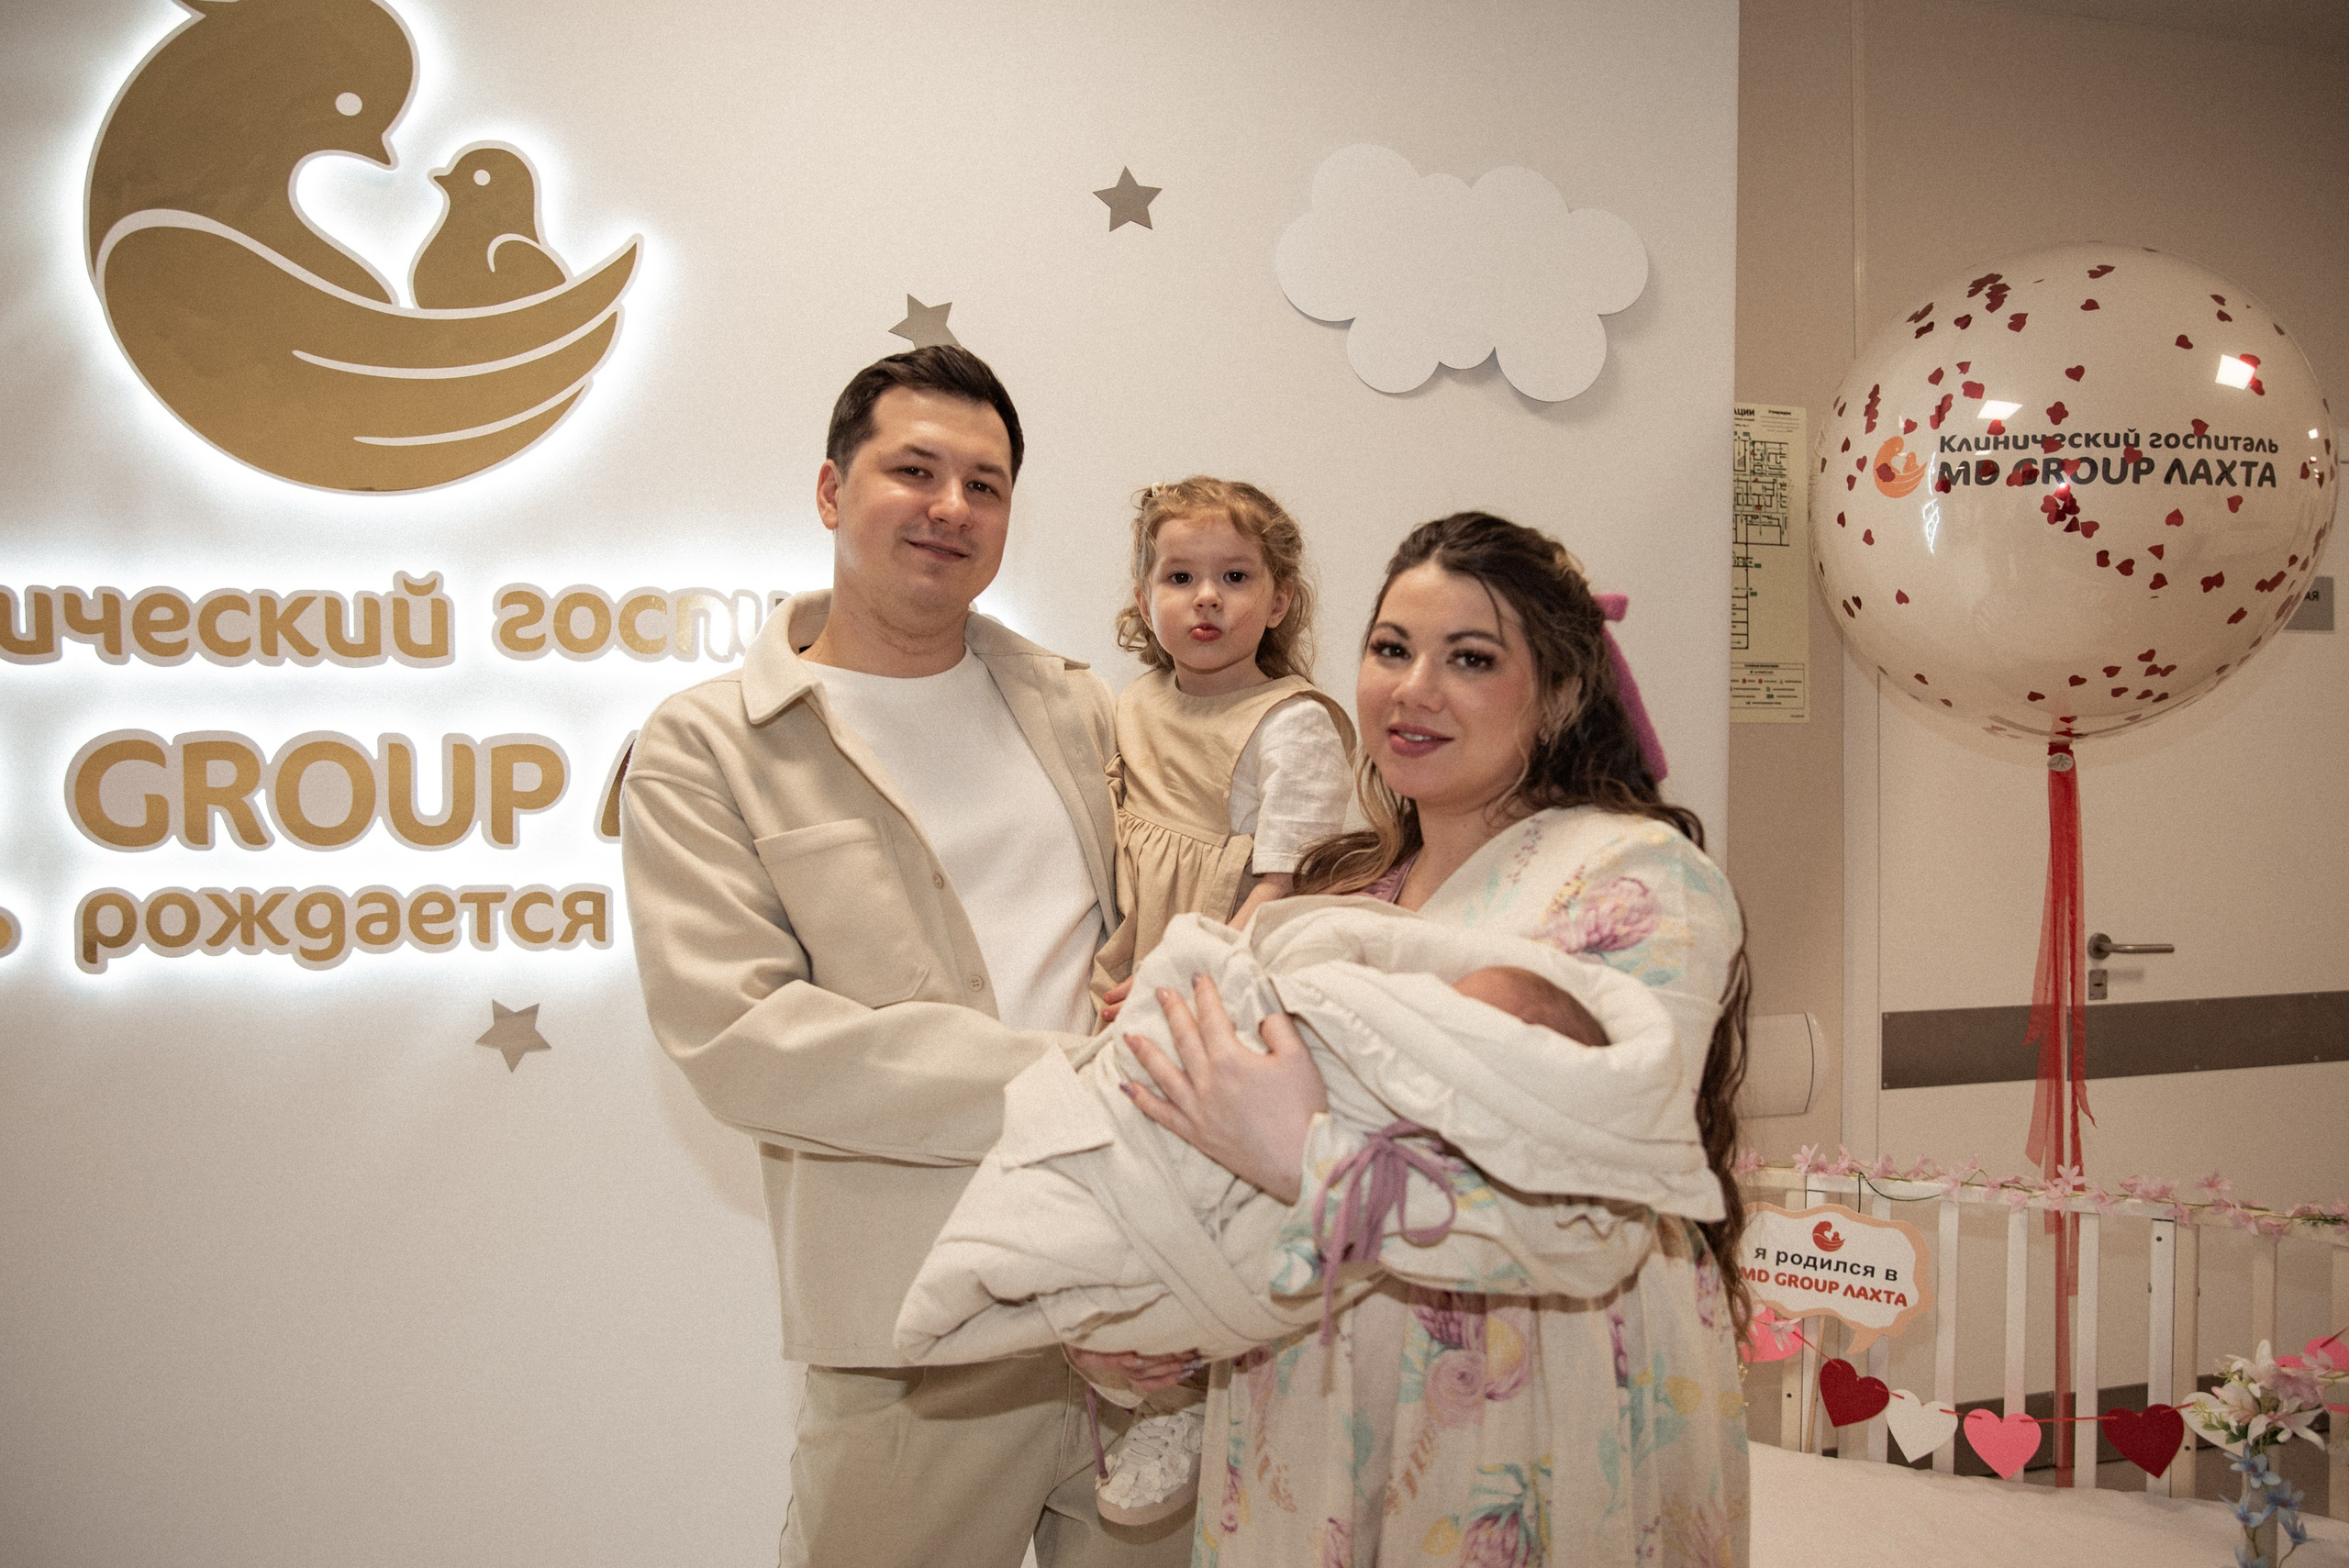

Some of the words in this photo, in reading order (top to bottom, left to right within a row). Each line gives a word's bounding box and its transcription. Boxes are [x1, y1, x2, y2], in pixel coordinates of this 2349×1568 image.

[2149, 433, 2278, 453] госпиталь
[1938, 461, 2000, 486] MD
[74, 740, 565, 847] GROUP
[83, 892, 607, 964] рождается
[1741, 1266, 1770, 1283] MD
[1774, 1273, 1840, 1294] GROUP
[1753, 1248, 1767, 1260] я
[1776, 1251, 1875, 1277] родился
[1885, 1269, 1898, 1282] в
